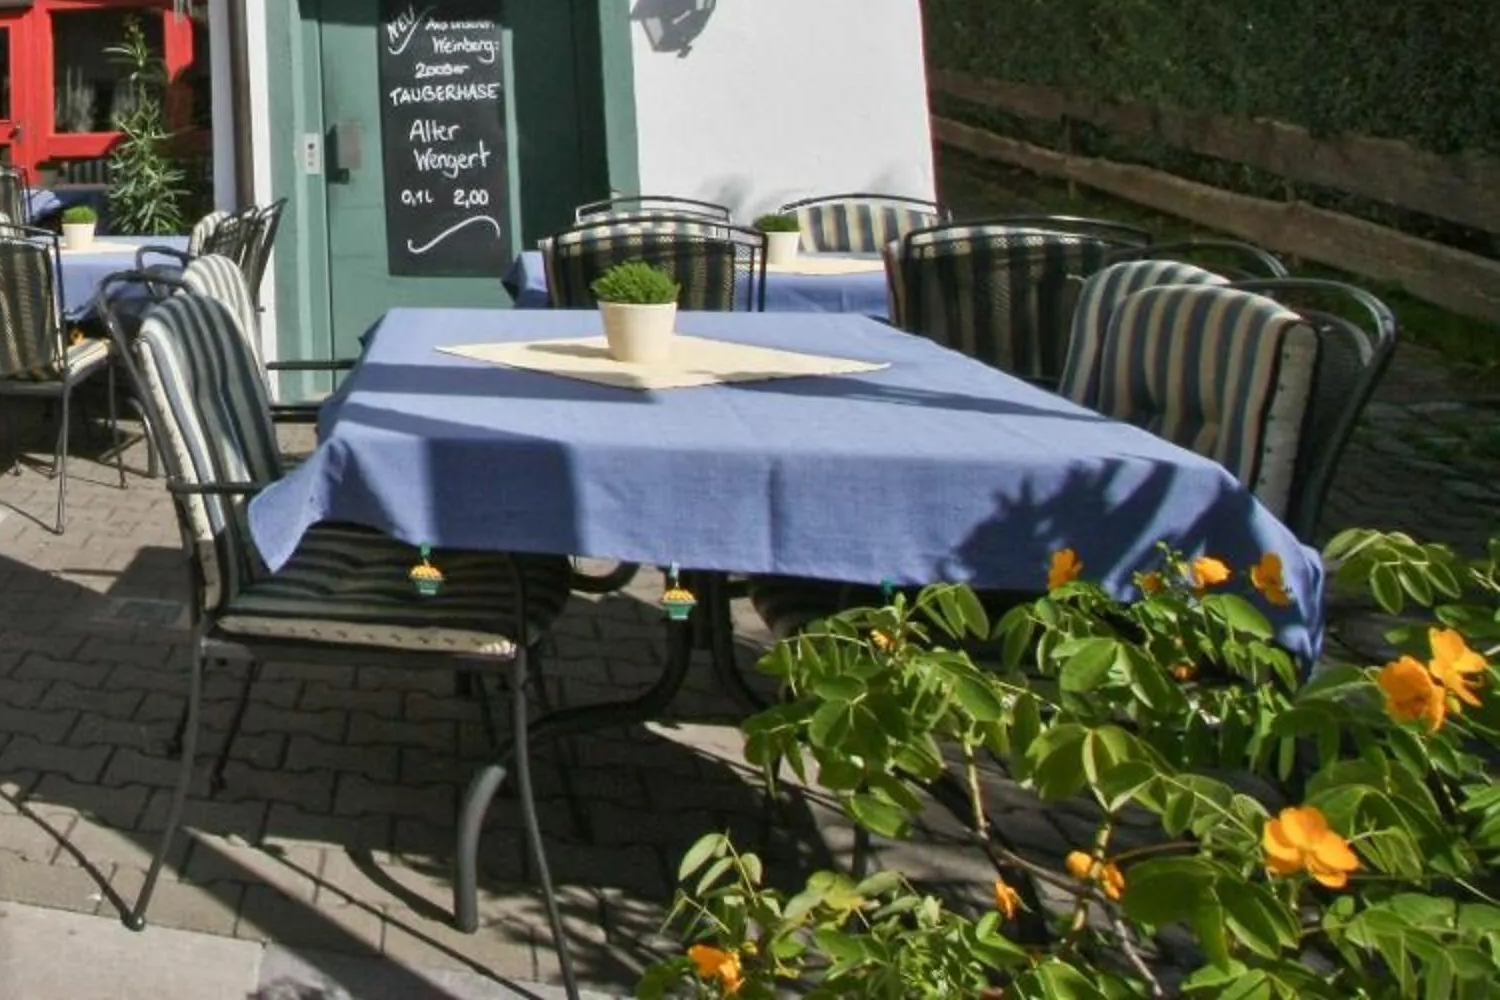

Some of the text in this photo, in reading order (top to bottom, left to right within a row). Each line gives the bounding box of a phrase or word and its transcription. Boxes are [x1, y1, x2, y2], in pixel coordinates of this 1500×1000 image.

[389, 83, 500, 105] TAUBERHASE
[409, 119, 460, 142] Alter
[413, 140, 490, 178] Wengert
[453, 189, 489, 208] 2,00
